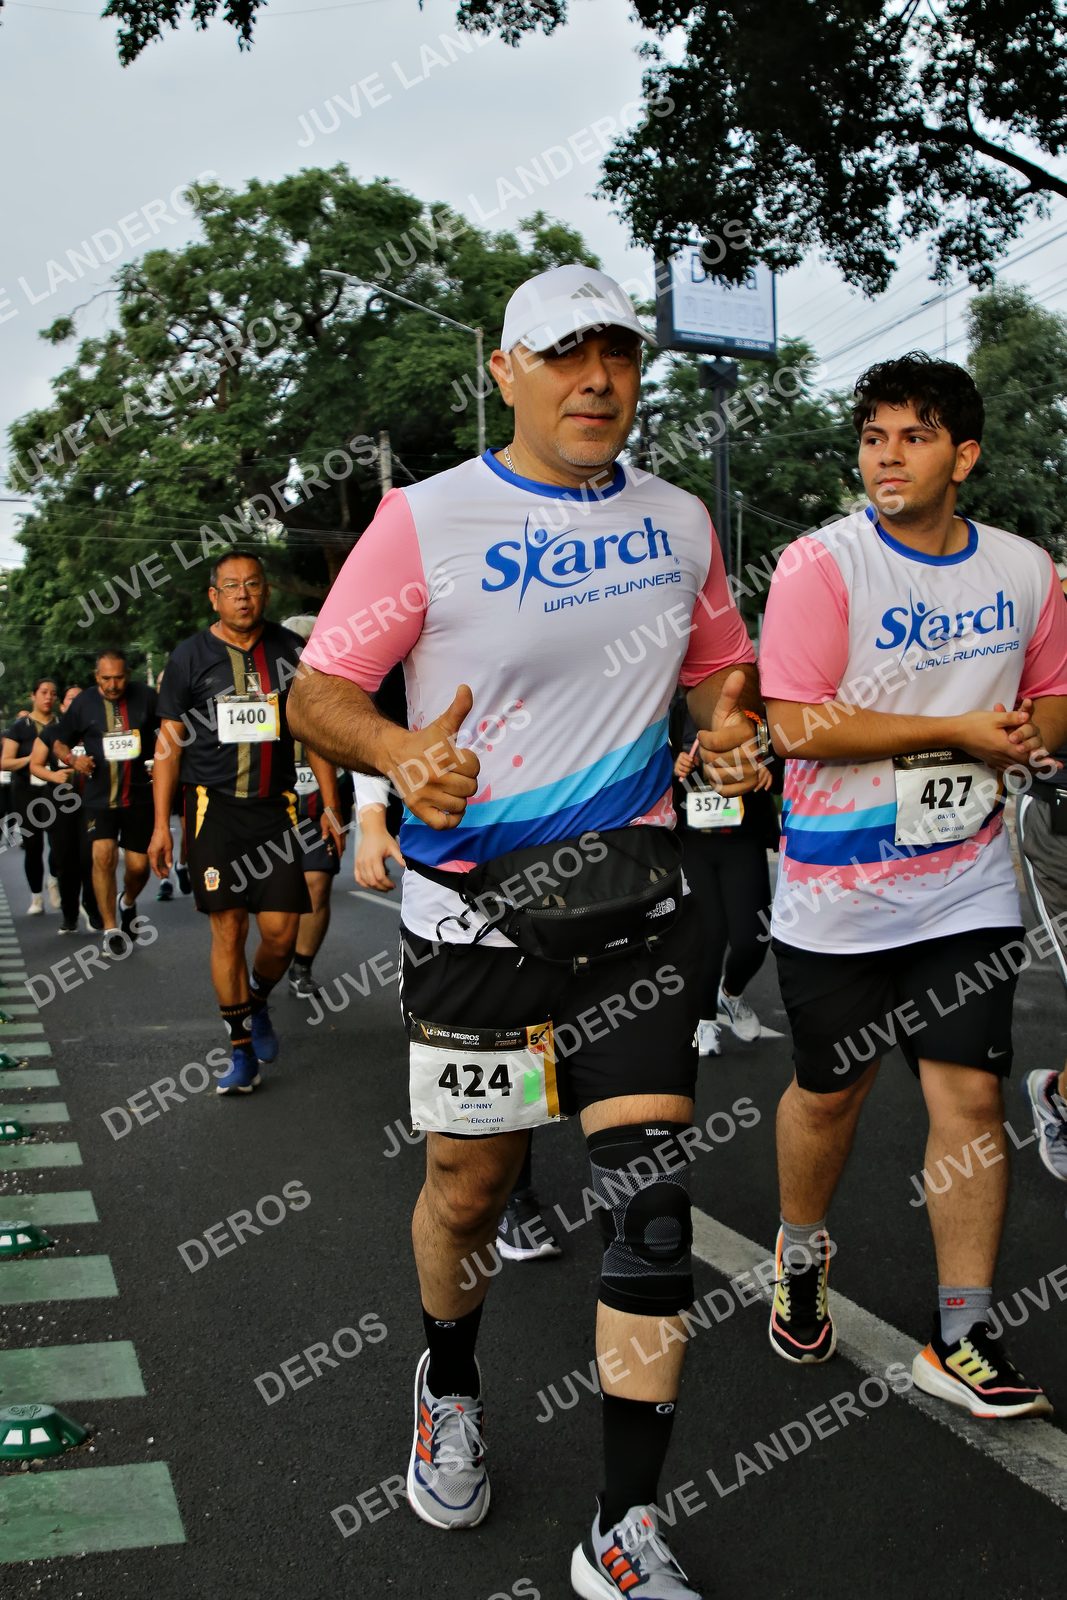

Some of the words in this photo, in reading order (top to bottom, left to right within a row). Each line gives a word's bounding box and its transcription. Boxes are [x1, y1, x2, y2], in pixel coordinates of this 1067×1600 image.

[545, 589, 599, 612] WAVE
[605, 571, 681, 598] RUNNERS
[915, 655, 950, 671] WAVE
[953, 641, 1019, 662] RUNNERS
[226, 708, 266, 725] 1400
[109, 740, 133, 750] 5594
[920, 775, 973, 809] 427
[695, 797, 731, 812] 3572
[451, 1032, 480, 1041] NEGROS
[438, 1063, 513, 1097] 424
[645, 1128, 669, 1136] Wilson
